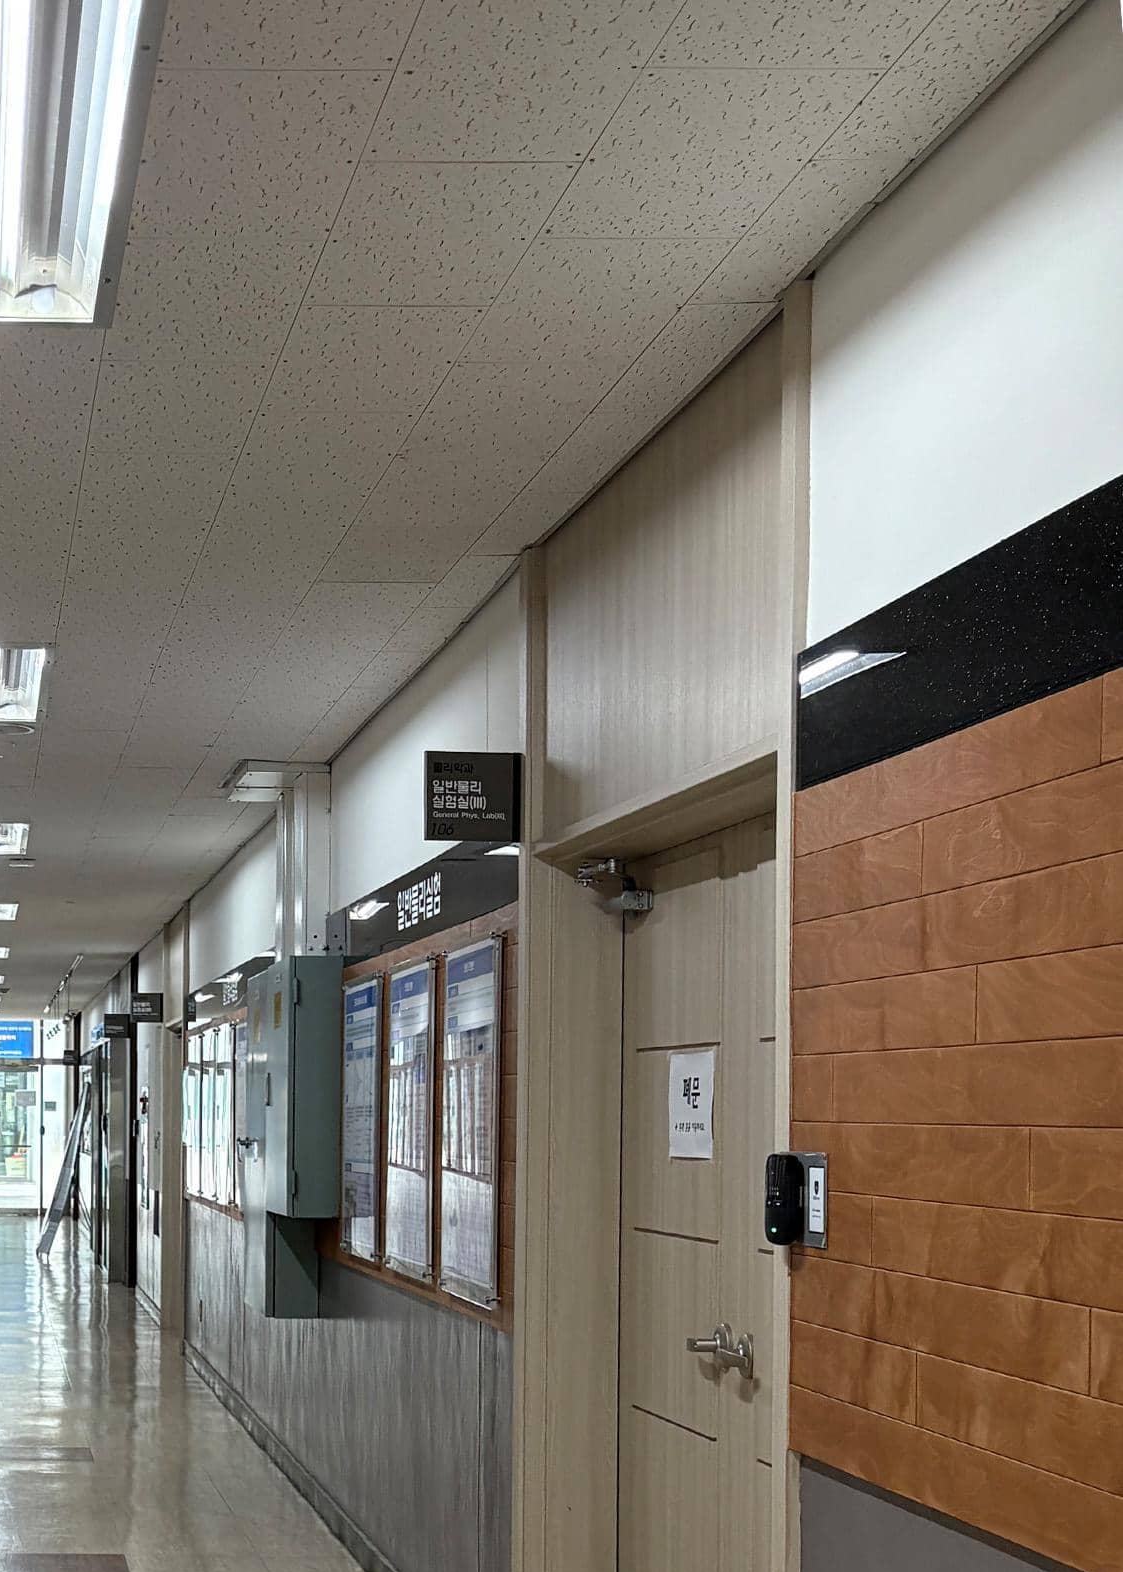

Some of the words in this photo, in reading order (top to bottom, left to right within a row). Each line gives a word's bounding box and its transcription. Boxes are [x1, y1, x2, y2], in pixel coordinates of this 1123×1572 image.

[432, 780, 482, 794] 일반물리
[432, 795, 487, 810] 실험실(III)
[430, 823, 454, 836] 106
[397, 872, 442, 932] 일반물리실험
